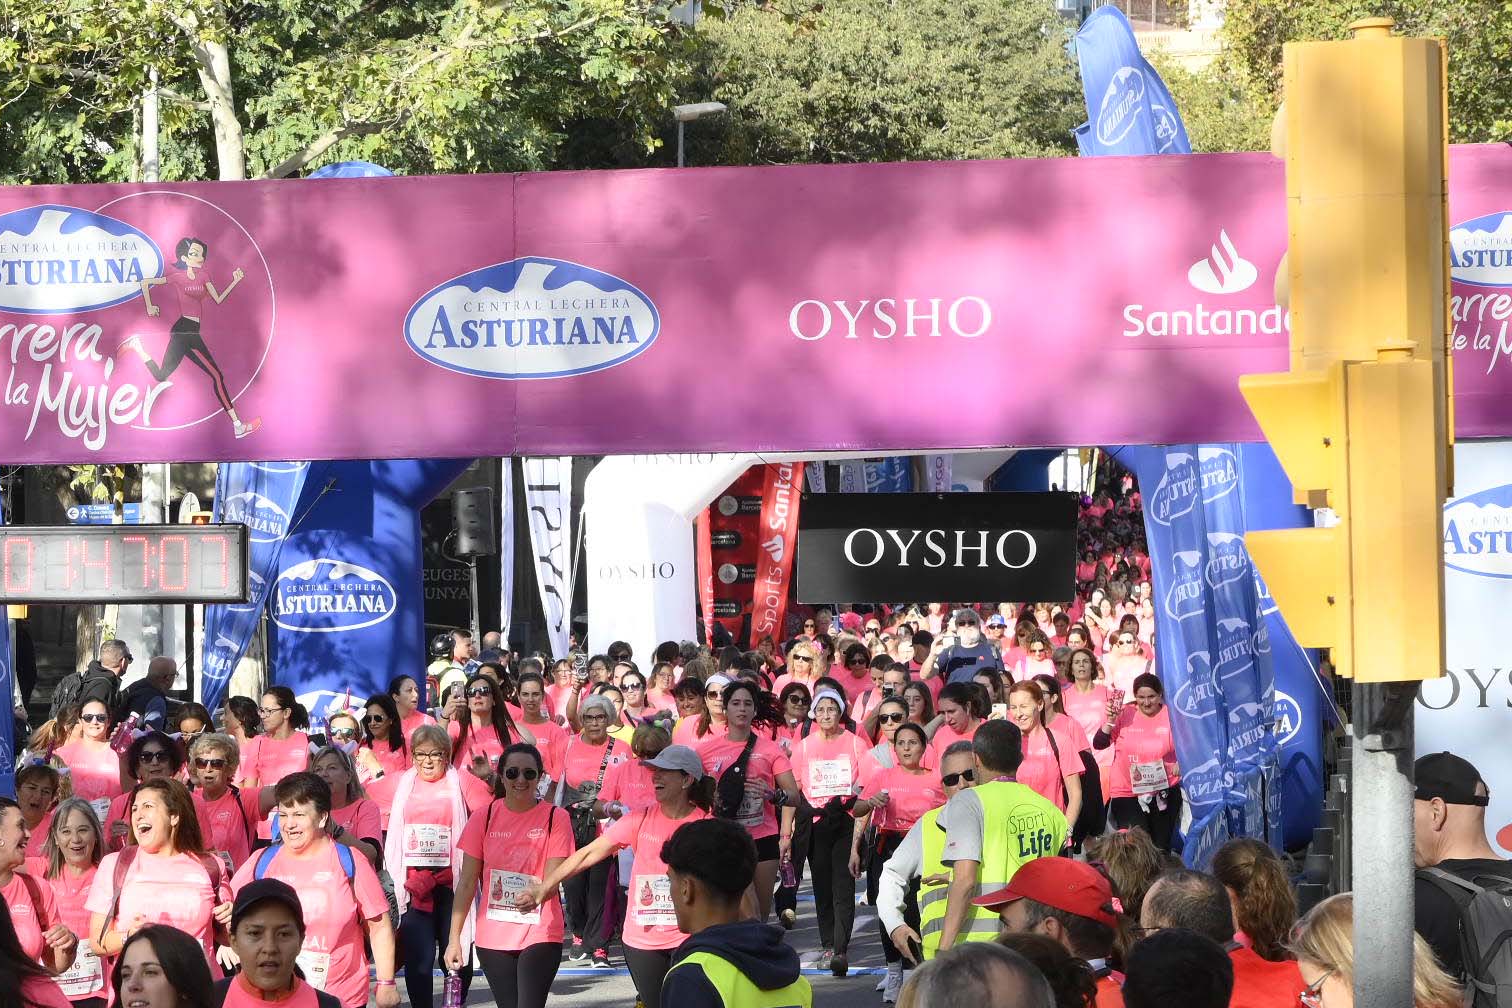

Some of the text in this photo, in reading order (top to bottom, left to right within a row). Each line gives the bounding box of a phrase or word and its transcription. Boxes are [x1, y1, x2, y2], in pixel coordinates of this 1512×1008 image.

[549, 297, 631, 311] LECHERA
[789, 297, 992, 341] OYSHO
[424, 298, 638, 349] ASTURIANA
[1123, 304, 1289, 338] Santand
[4, 368, 30, 405] la
[25, 357, 174, 450] Mujer
[843, 528, 1038, 570] OYSHO
[275, 589, 388, 616] ASTURIANA
[287, 582, 383, 593] CENTRAL LECHERA
[424, 586, 470, 601] UNYA
[757, 566, 784, 635] Sports
[1009, 811, 1047, 835] Sport
[1017, 828, 1053, 859] Life
